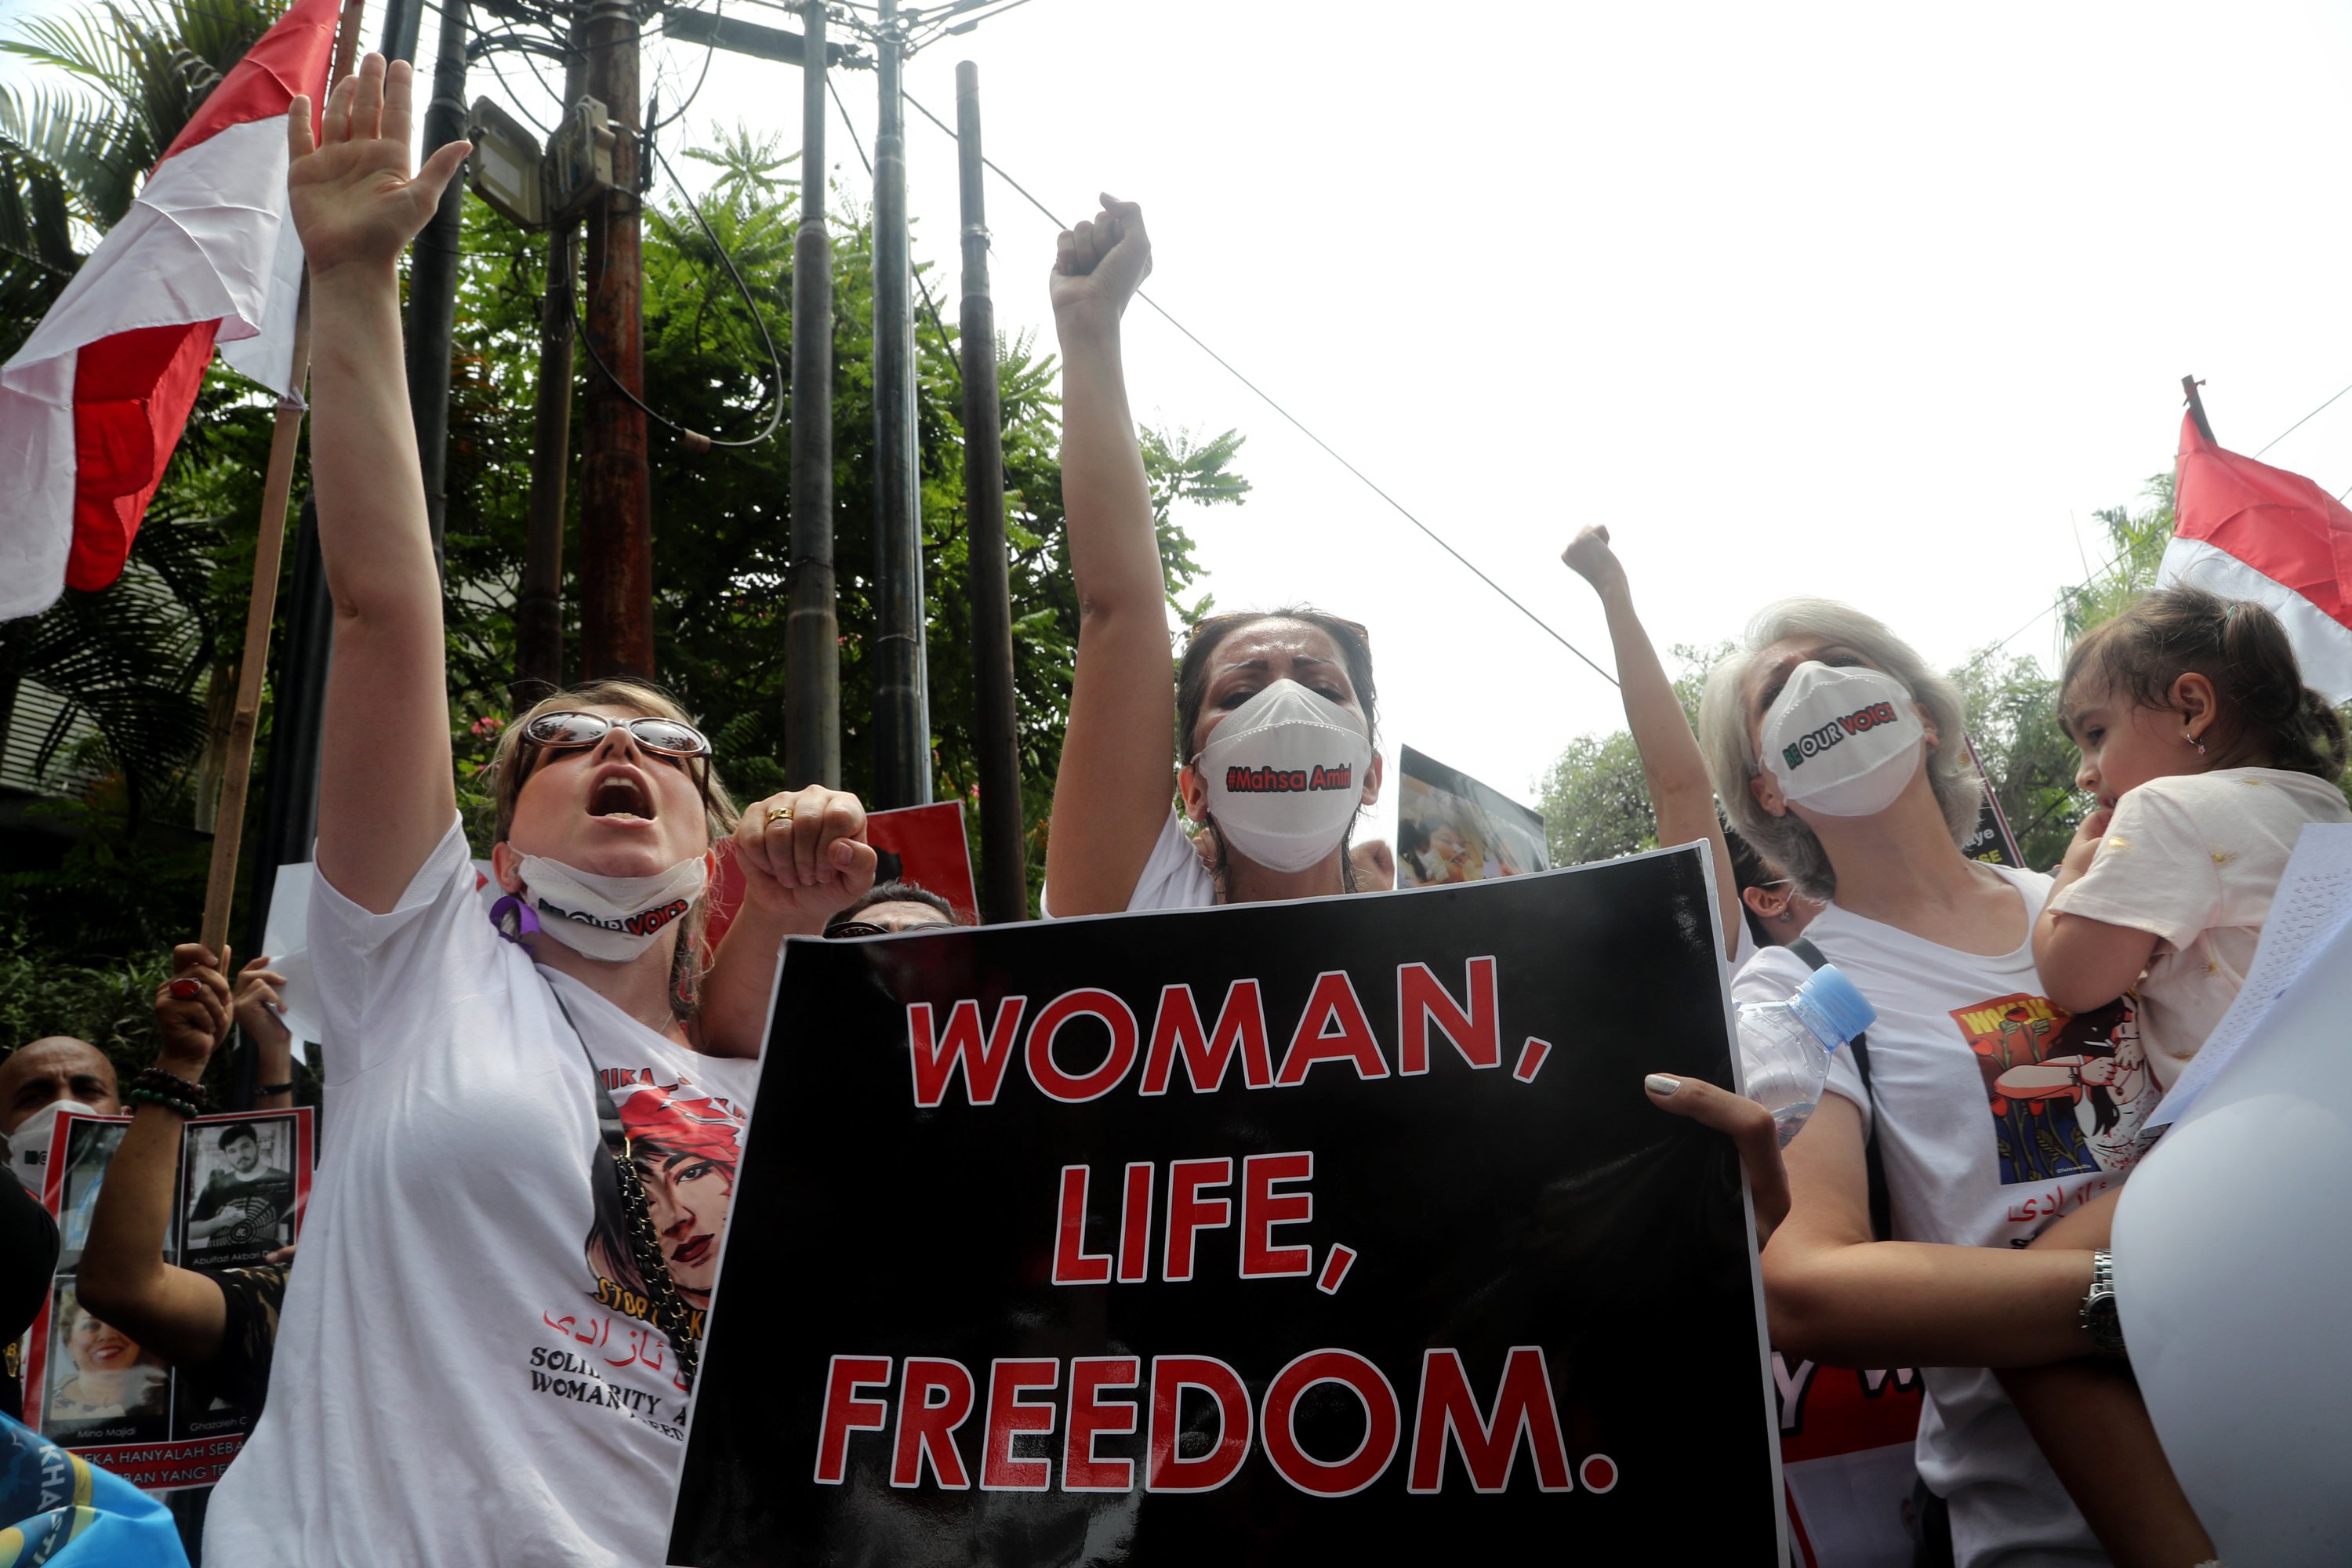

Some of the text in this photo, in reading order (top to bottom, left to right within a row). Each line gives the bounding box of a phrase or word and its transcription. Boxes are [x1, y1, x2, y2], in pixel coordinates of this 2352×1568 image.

[1782, 701, 1898, 770] BE OUR VOICE
[1226, 766, 1307, 792] #Mahsa
[906, 954, 1552, 1108] WOMAN,
[1051, 1149, 1357, 1295] LIFE,
[593, 1276, 648, 1320] STOP
[77, 1430, 103, 1439] Mino
[190, 1418, 238, 1432] Ghazaleh
[813, 1345, 1620, 1498] FREEDOM.
[119, 1446, 205, 1464] HANYALAH
[209, 1441, 244, 1457] SEBA
[161, 1466, 208, 1482] YANG
